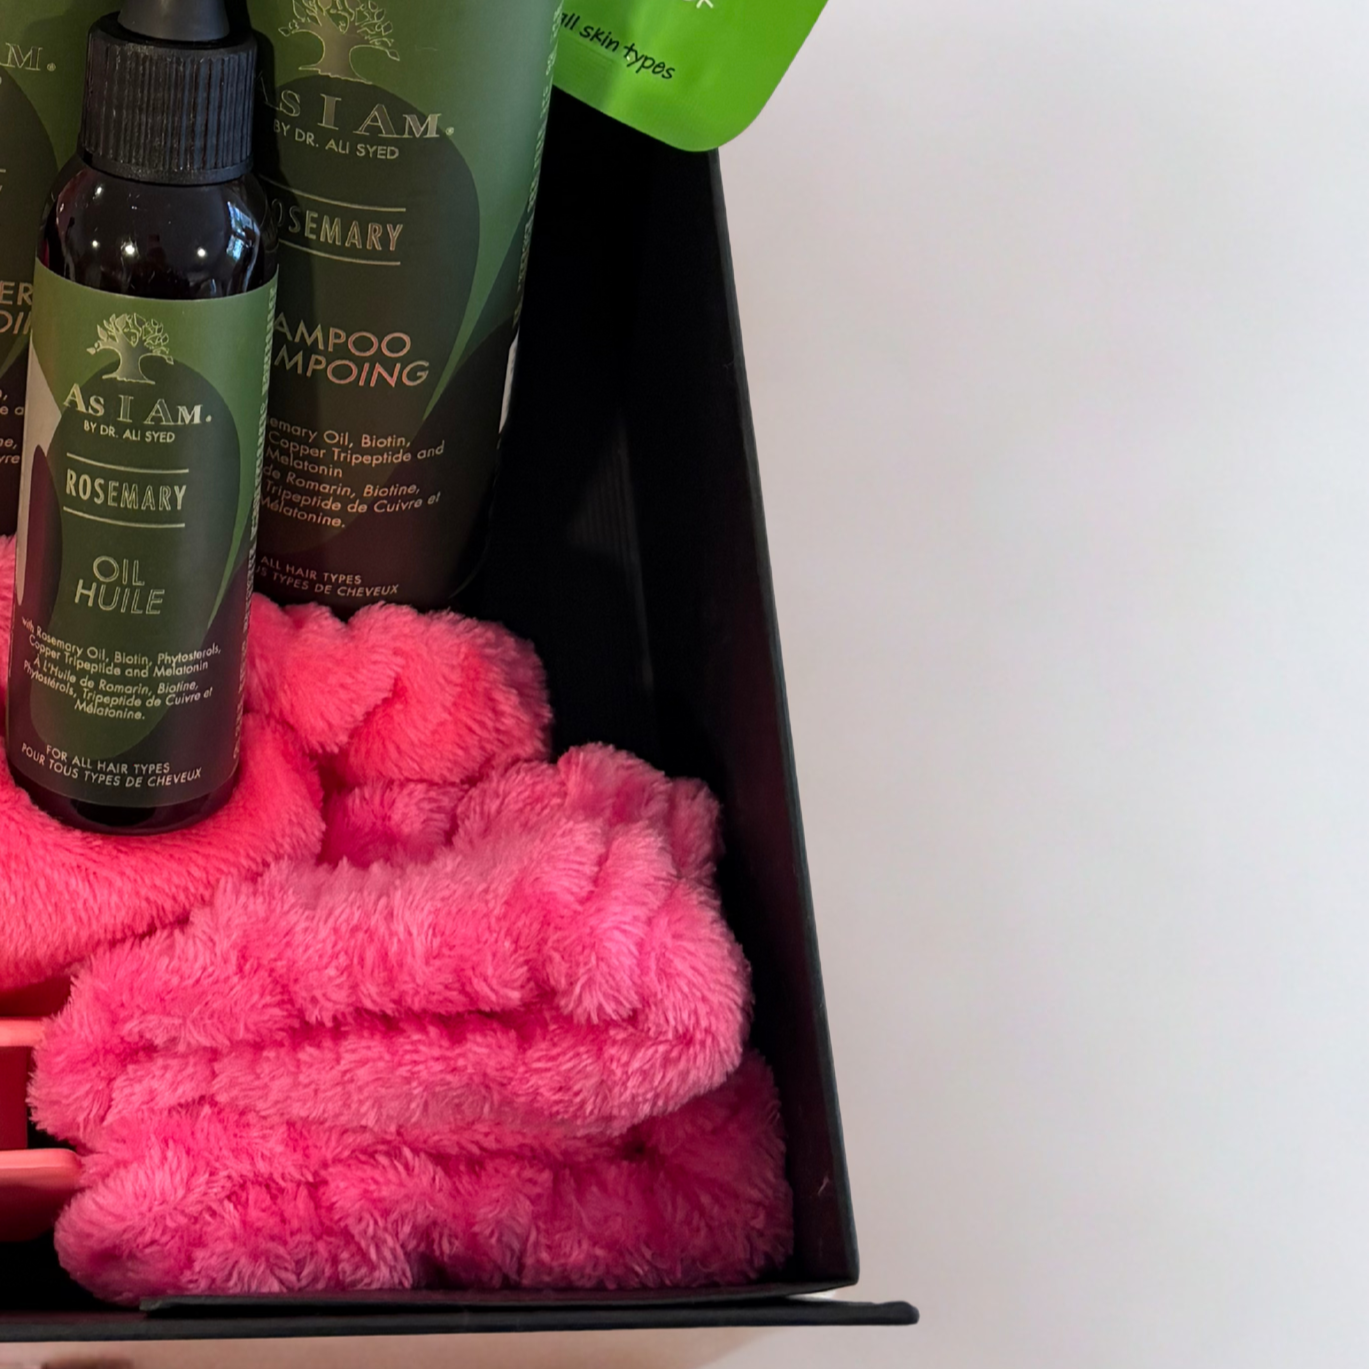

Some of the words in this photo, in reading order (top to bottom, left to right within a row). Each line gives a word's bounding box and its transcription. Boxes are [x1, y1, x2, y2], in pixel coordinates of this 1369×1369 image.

[579, 25, 620, 53] skin
[623, 42, 676, 80] types
[317, 93, 342, 130] I
[294, 127, 319, 148] DR.
[325, 138, 350, 154] ALI
[356, 144, 400, 160] SYED
[274, 312, 411, 358] AMPOO
[274, 344, 430, 388] MPOING
[117, 394, 134, 422] I
[83, 420, 97, 433] BY
[100, 424, 119, 438] DR.
[122, 428, 141, 441] ALI
[145, 431, 176, 443] SYED
[269, 430, 326, 458] Copper
[332, 447, 412, 467] Tripeptide
[416, 439, 445, 459] and
[323, 430, 354, 448] Oil,
[361, 433, 411, 449] Biotin,
[266, 446, 343, 478] Melatonin
[66, 468, 187, 511] ROSEMARY
[266, 478, 342, 511] Tripeptide
[347, 499, 368, 514] de
[373, 497, 422, 513] Cuivre
[286, 472, 356, 498] Romarin,
[363, 483, 420, 497] Biotine,
[92, 555, 145, 587] OIL
[272, 572, 309, 590] TYPES
[314, 583, 333, 595] DE
[337, 584, 399, 597] CHEVEUX
[285, 564, 317, 580] HAIR
[323, 572, 362, 585] TYPES
[74, 579, 165, 615] HUILE
[29, 634, 61, 660] Copper
[64, 652, 121, 675] Tripeptide
[125, 663, 149, 678] and
[153, 660, 209, 677] Melatonin
[36, 625, 83, 657] Rosemary
[87, 646, 109, 663] Oil,
[114, 651, 152, 666] Biotin,
[157, 642, 221, 666] Phytosterols,
[43, 660, 77, 684] L'Huile
[79, 675, 95, 689] de
[99, 679, 152, 697] Romarin,
[157, 681, 198, 694] Biotine,
[82, 688, 142, 707] Tripeptide
[145, 695, 162, 707] de
[165, 692, 201, 706] Cuivre
[21, 742, 45, 766] POUR
[48, 758, 79, 779] TOUS
[84, 770, 121, 787] TYPES
[125, 776, 143, 788] DE
[147, 767, 202, 788] CHEVEUX
[46, 744, 68, 763] FOR
[72, 755, 93, 769] ALL
[97, 760, 128, 774] HAIR
[133, 762, 170, 775] TYPES
